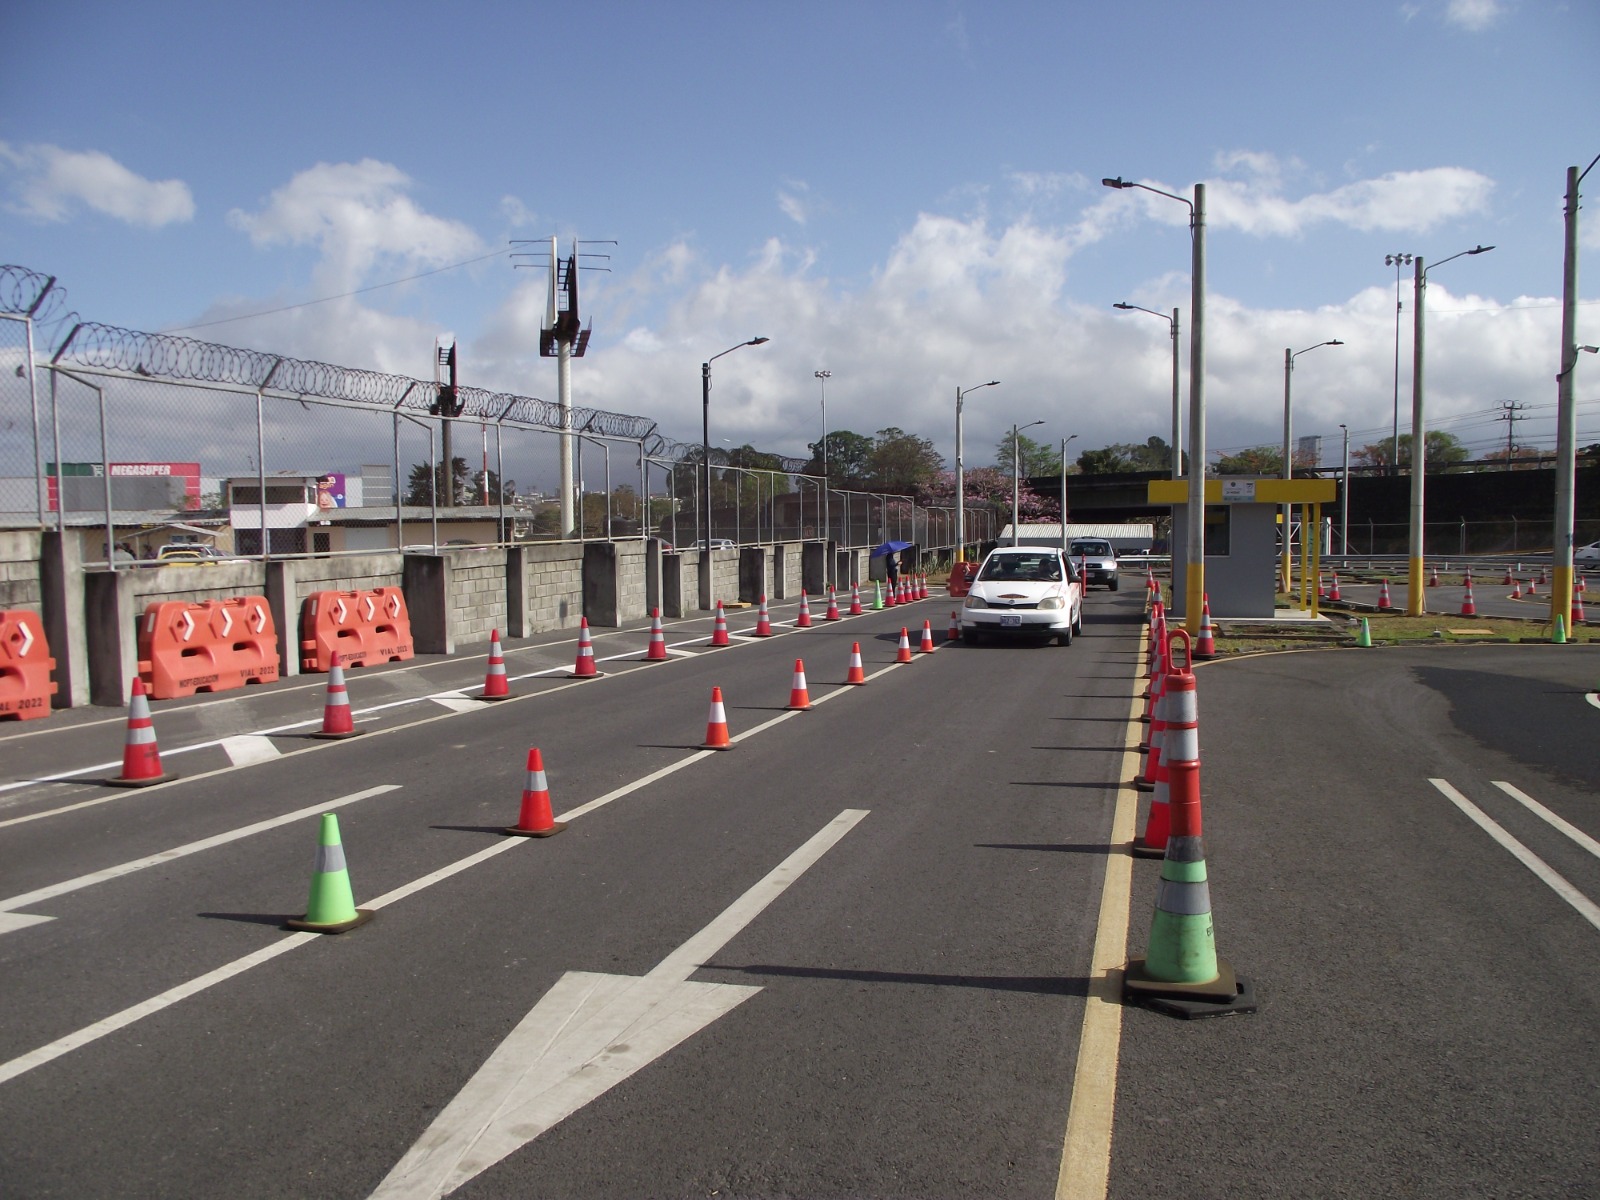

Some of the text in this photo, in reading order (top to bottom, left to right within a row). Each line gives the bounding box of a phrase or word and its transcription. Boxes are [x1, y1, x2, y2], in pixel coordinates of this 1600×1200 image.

[111, 465, 171, 476] MEGASUPER
[380, 646, 395, 656] VIAL
[240, 667, 255, 678] VIAL
[259, 665, 274, 675] 2022
[18, 697, 43, 709] 2022
